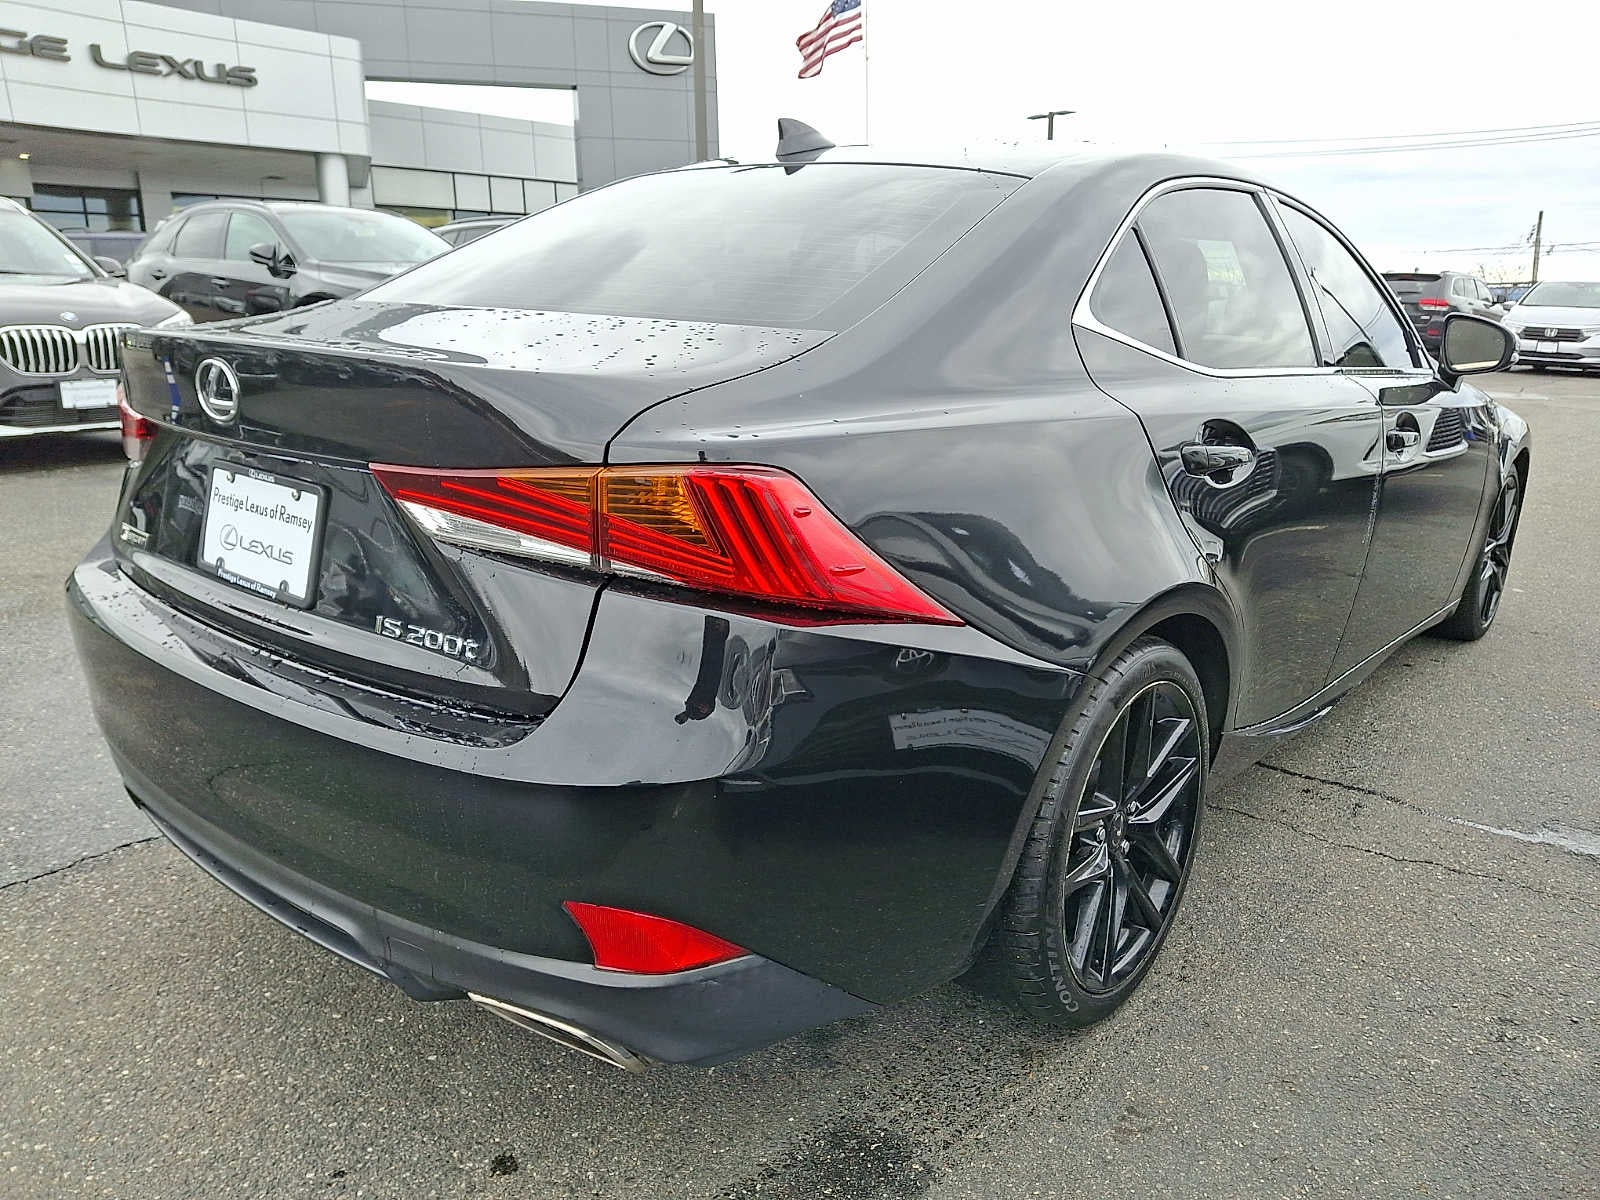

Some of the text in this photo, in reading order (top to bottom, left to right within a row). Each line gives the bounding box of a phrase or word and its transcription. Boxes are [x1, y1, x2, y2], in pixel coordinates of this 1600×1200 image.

[89, 43, 258, 88] LEXUS
[213, 487, 244, 512] Prestige
[245, 496, 268, 518] Lexus
[269, 504, 279, 520] of
[280, 505, 313, 533] Ramsey
[239, 535, 294, 565] LEXUS
[218, 568, 237, 584] Prestige
[237, 576, 251, 589] Lexus
[257, 582, 277, 599] Ramsey
[375, 615, 479, 660] IS 200t
